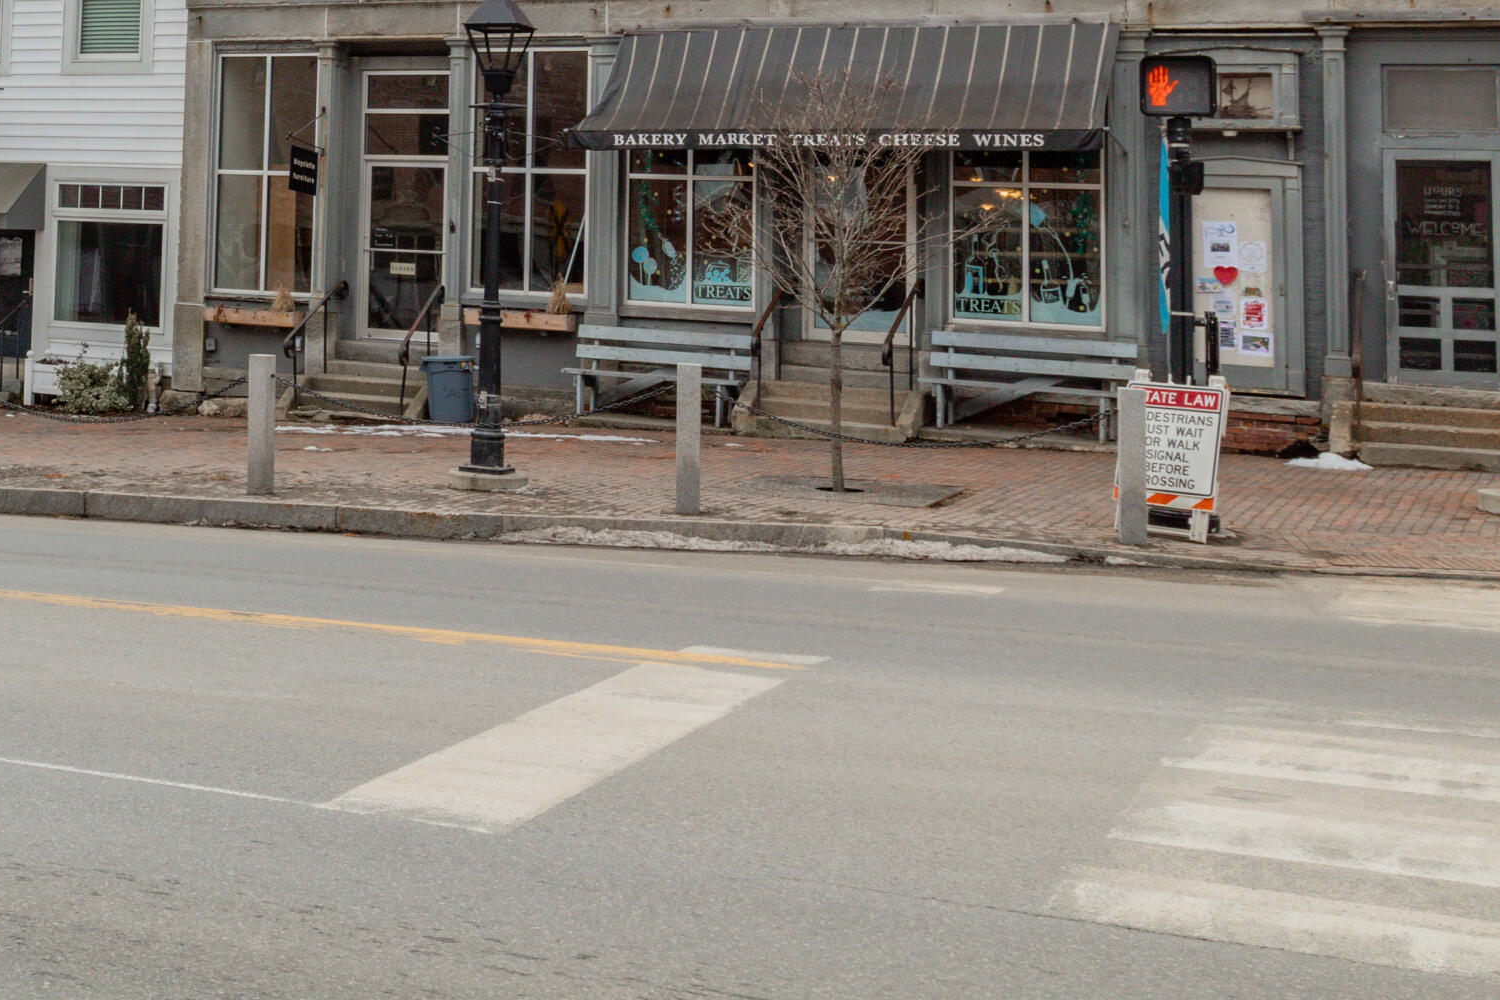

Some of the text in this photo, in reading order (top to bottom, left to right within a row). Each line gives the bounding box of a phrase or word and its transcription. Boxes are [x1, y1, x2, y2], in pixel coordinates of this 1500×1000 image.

[613, 133, 1046, 147] BAKERY MARKET TREATS CHEESE WINES
[1405, 221, 1485, 236] WELCOME
[698, 285, 751, 300] TREATS
[957, 299, 1021, 314] TREATS
[1145, 390, 1216, 408] TATE LAW
[1146, 411, 1214, 427] DESTRIANS
[1147, 425, 1205, 438] UST WAIT
[1145, 437, 1201, 452] OR WALK
[1146, 449, 1190, 463] SIGNAL
[1145, 474, 1196, 490] ROSSING
